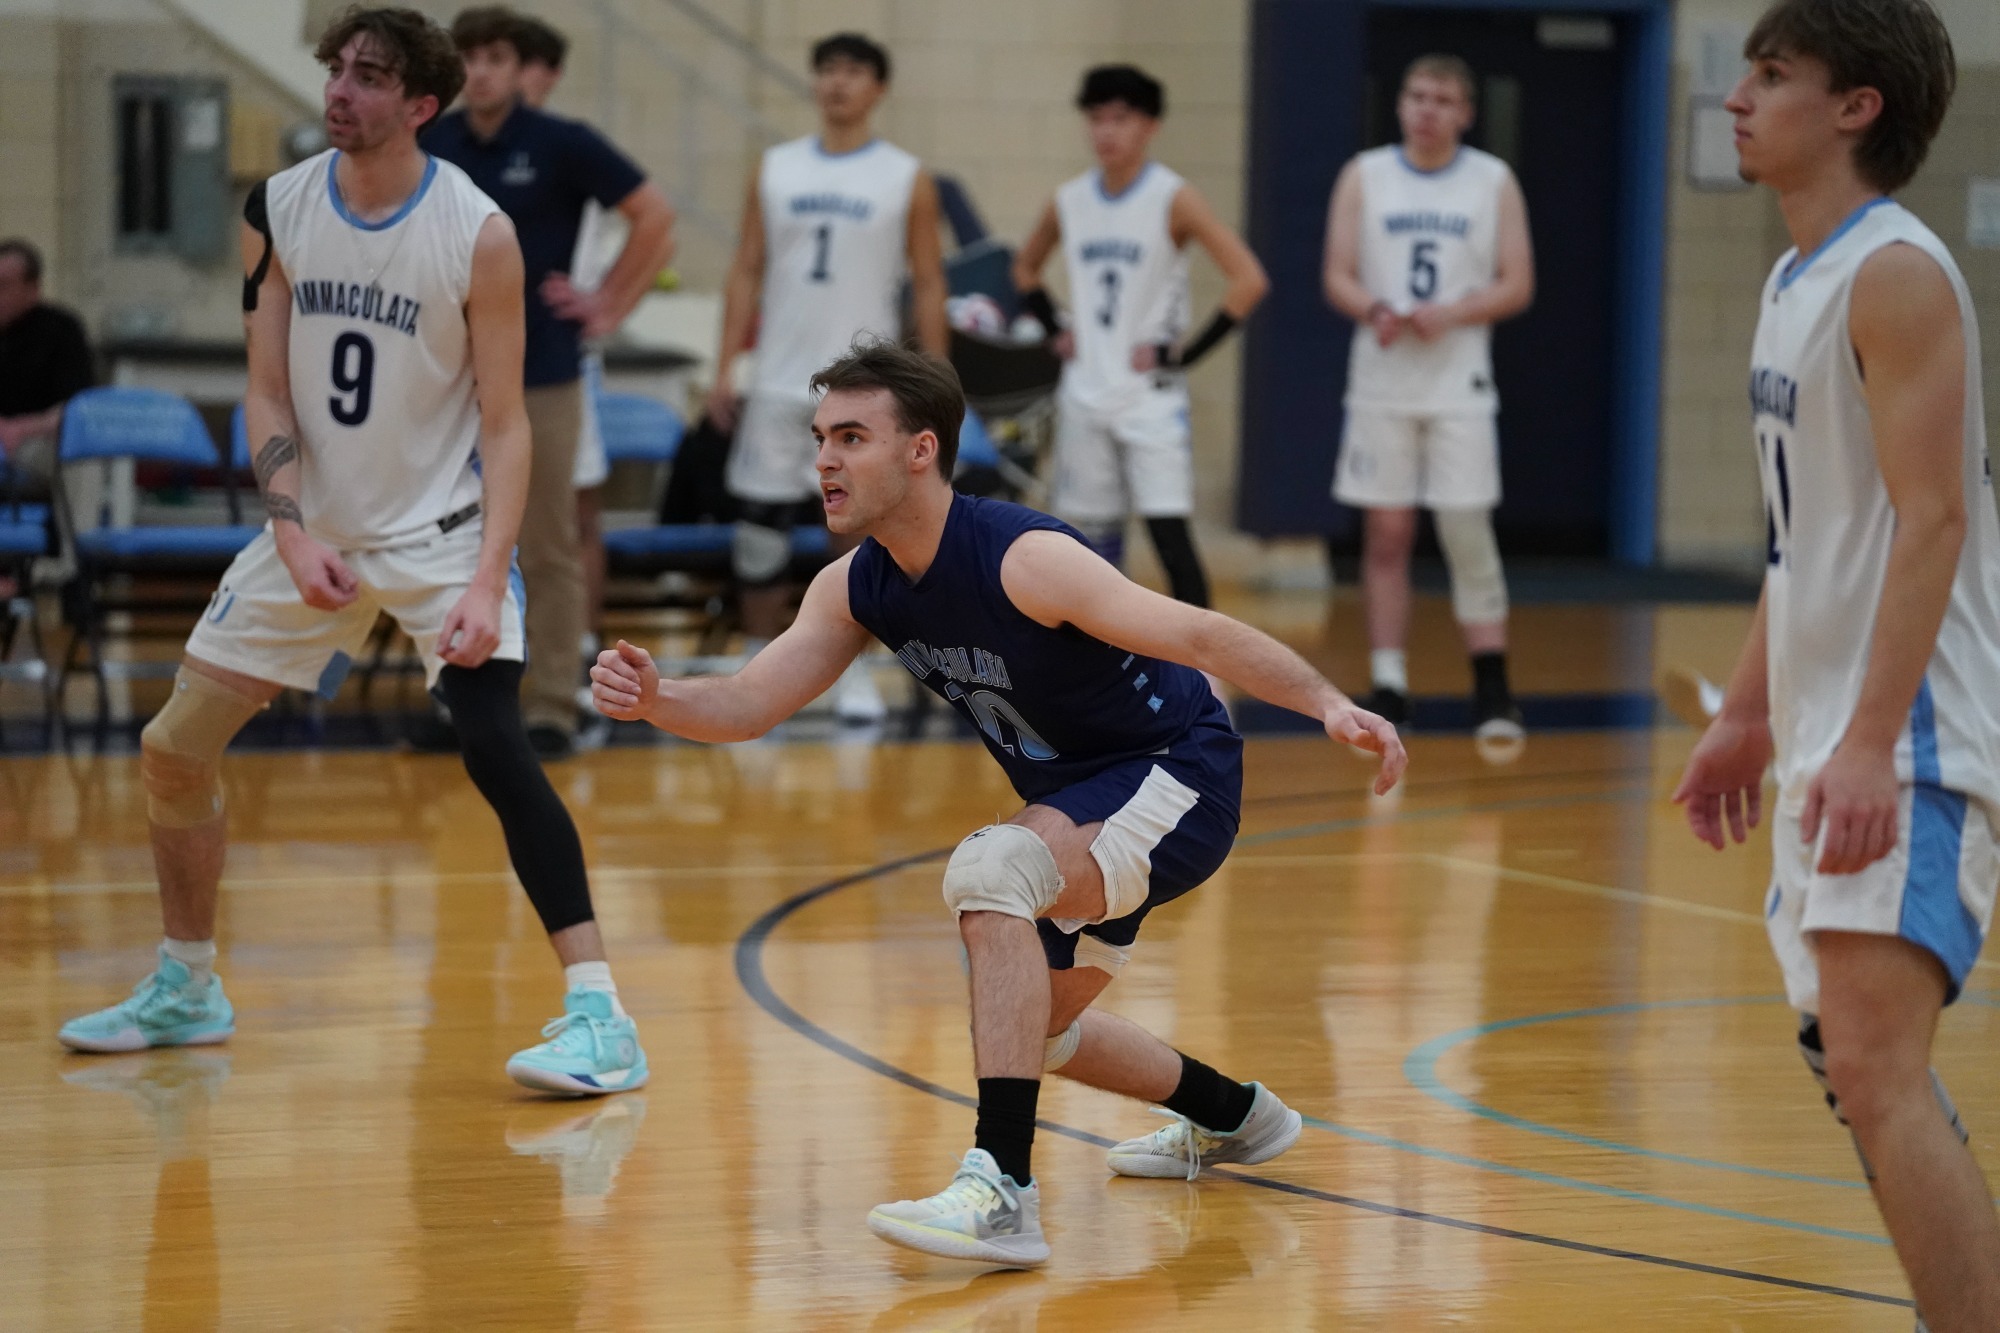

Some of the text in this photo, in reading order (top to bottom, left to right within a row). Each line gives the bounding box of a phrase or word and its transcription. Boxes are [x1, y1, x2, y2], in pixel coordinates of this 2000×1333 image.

[806, 224, 832, 283] 1
[1409, 240, 1438, 301] 5
[294, 279, 421, 338] IMMACULATA
[328, 328, 376, 428] 9
[896, 638, 1013, 691] IMCULATA
